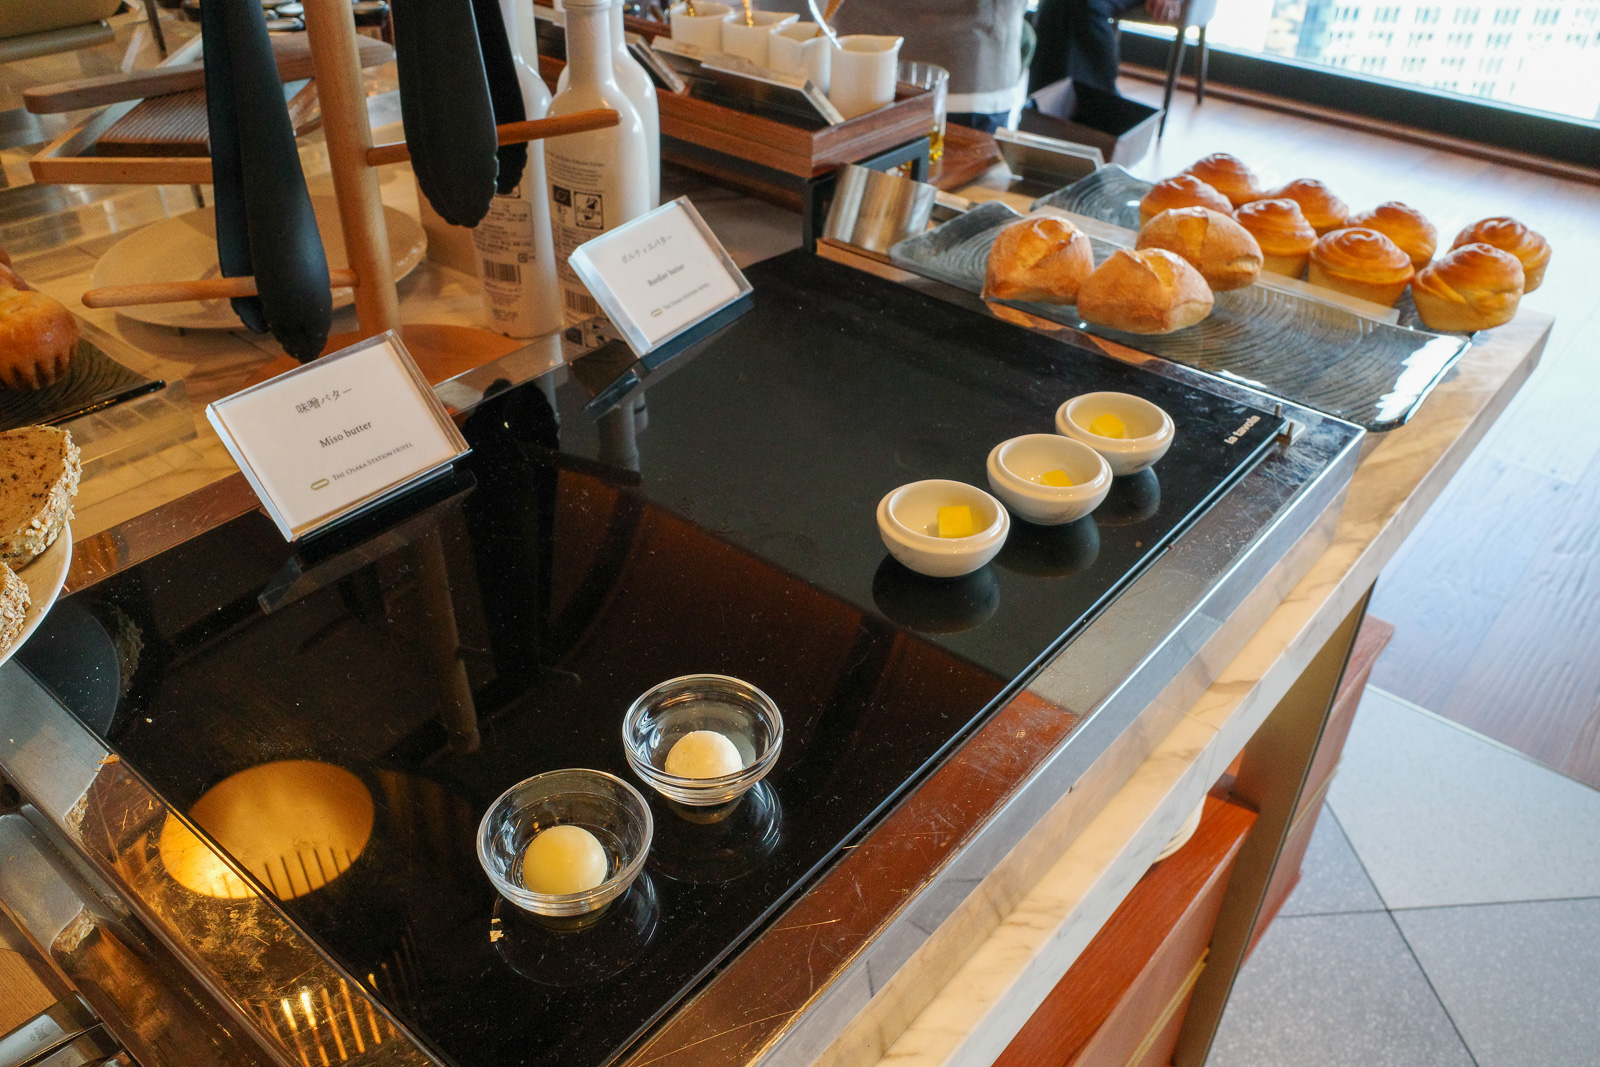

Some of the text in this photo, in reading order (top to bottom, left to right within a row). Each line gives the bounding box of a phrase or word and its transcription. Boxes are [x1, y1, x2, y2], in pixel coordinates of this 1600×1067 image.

[667, 264, 684, 275] butter
[295, 387, 353, 415] 味噌バター
[319, 421, 372, 448] Miso butter
[332, 442, 413, 481] THE OSAKA STATION HOTEL
